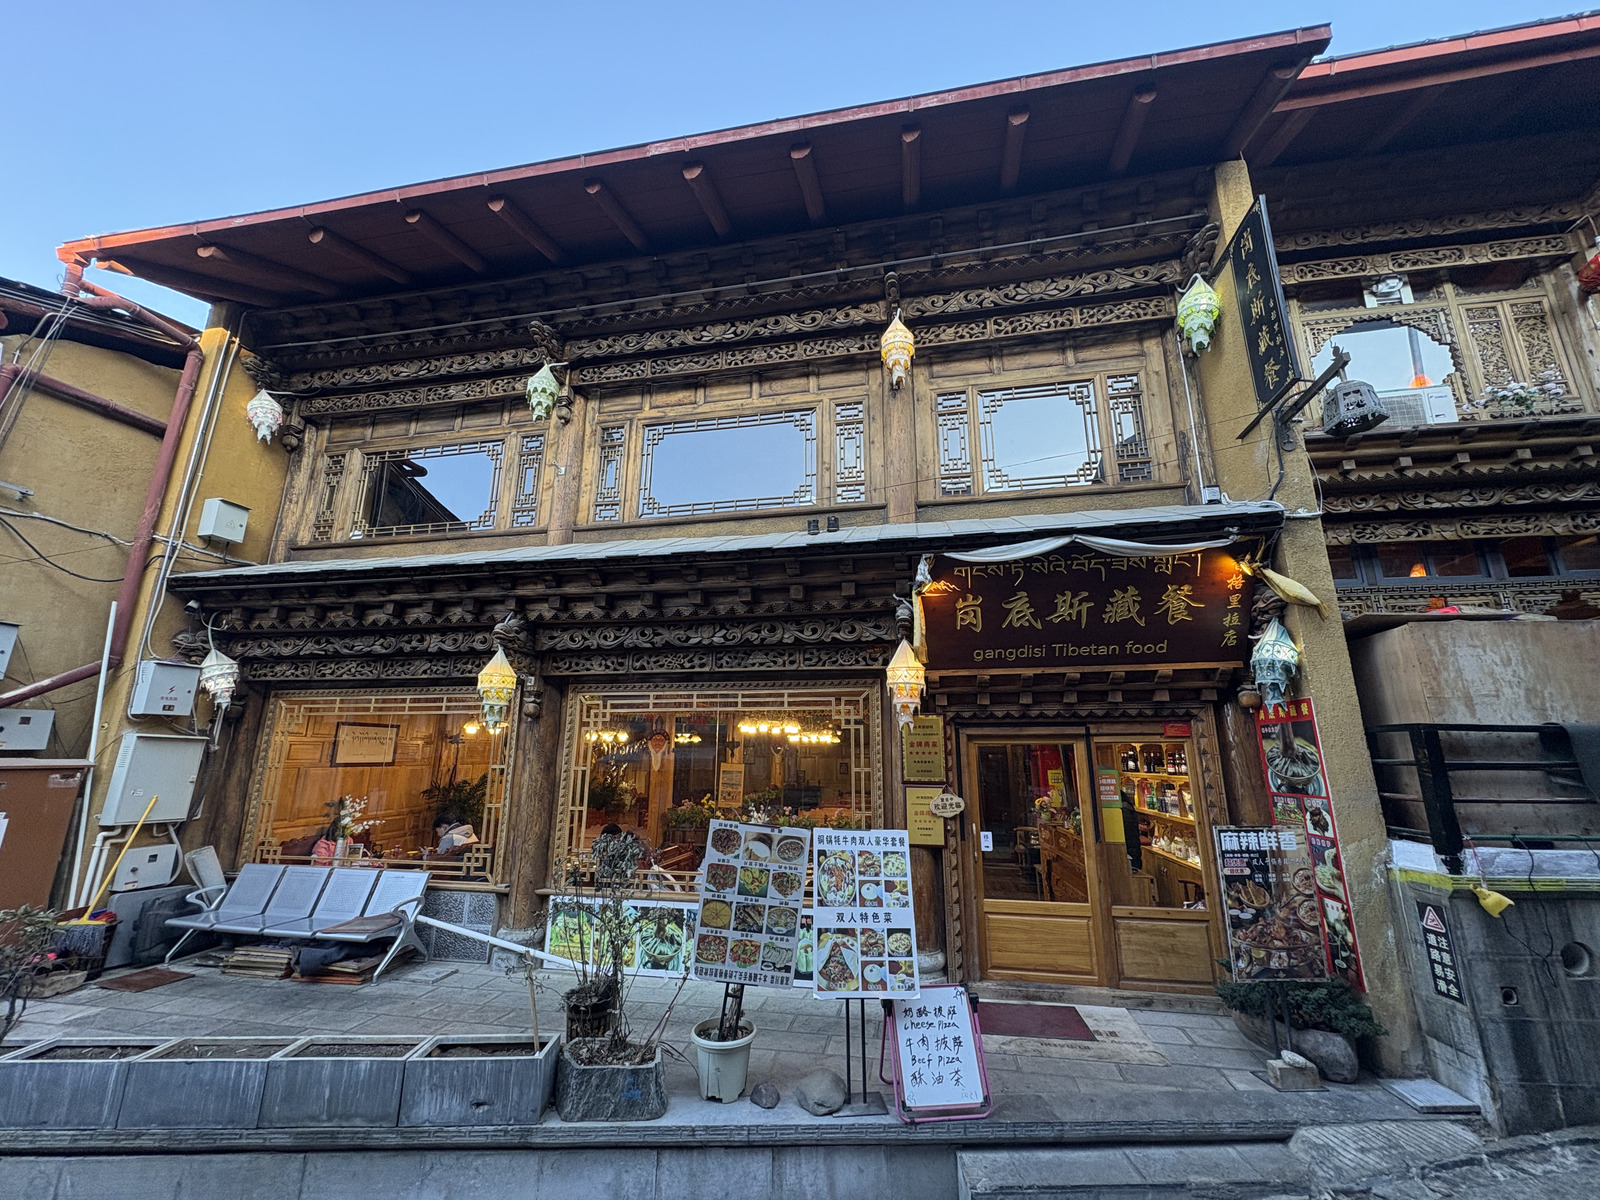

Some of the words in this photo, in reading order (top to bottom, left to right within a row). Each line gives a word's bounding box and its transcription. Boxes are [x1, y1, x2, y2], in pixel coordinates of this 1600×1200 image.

[1240, 228, 1281, 389] 岗底斯藏餐
[954, 583, 1205, 633] 岗底斯藏餐
[973, 643, 1046, 662] gangdisi
[1051, 641, 1121, 657] Tibetan
[1125, 640, 1168, 655] food
[934, 802, 962, 810] 欢迎光临
[817, 834, 906, 847] 铜锅牦牛肉双人豪华套餐
[1220, 831, 1298, 851] 麻辣鲜香
[836, 912, 892, 924] 双人特色菜
[1437, 935, 1460, 998] 注意安全
[902, 1004, 958, 1019] 奶酪披萨
[905, 1033, 964, 1055] 牛肉披萨
[911, 1053, 933, 1069] Beef
[910, 1068, 966, 1089] 酥油茶
